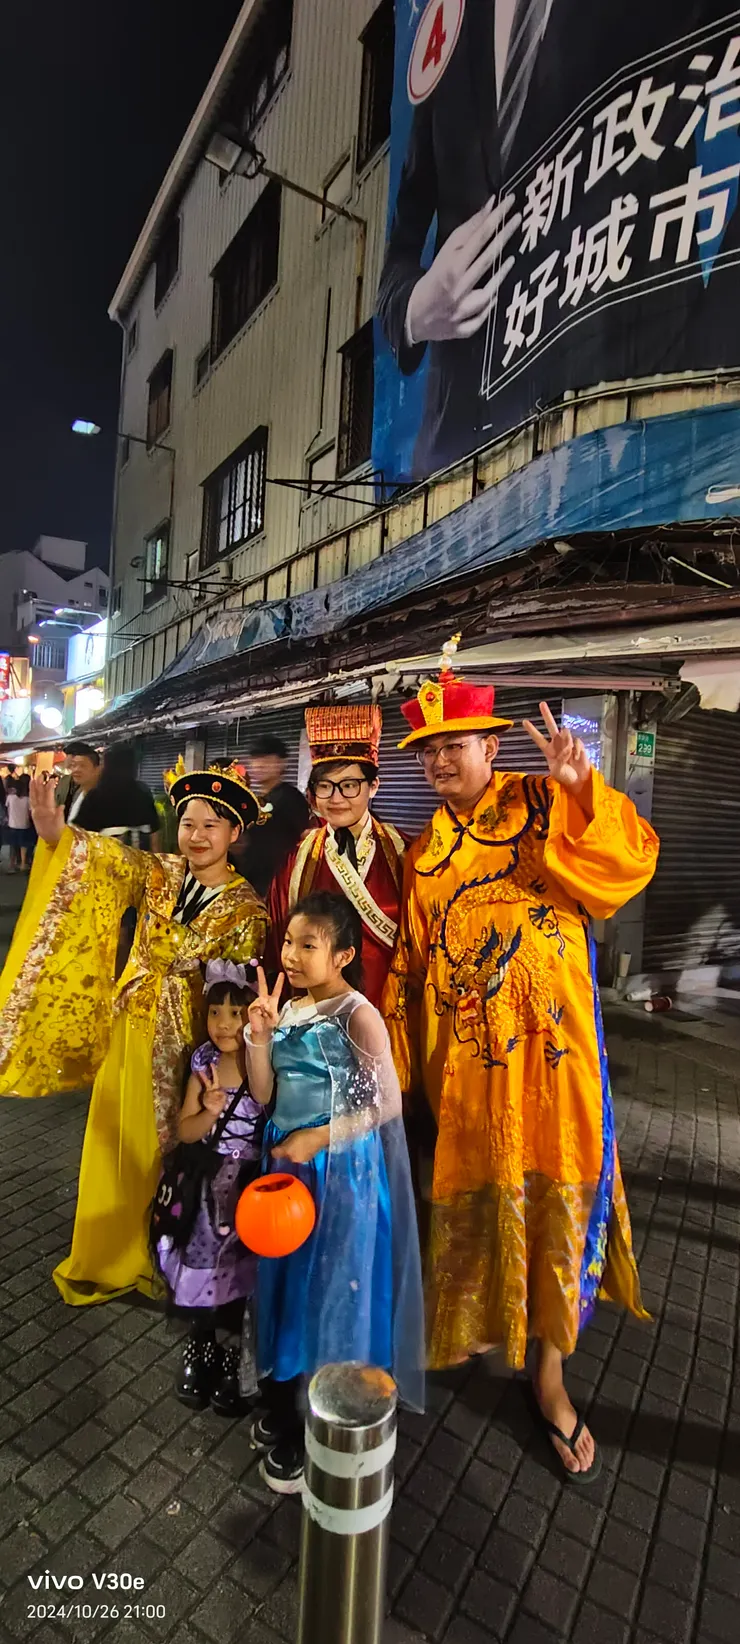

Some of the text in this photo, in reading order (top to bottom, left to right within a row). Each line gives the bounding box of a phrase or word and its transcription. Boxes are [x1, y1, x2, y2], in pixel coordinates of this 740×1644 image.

[422, 1, 447, 73] 4
[501, 164, 740, 368] 好城市
